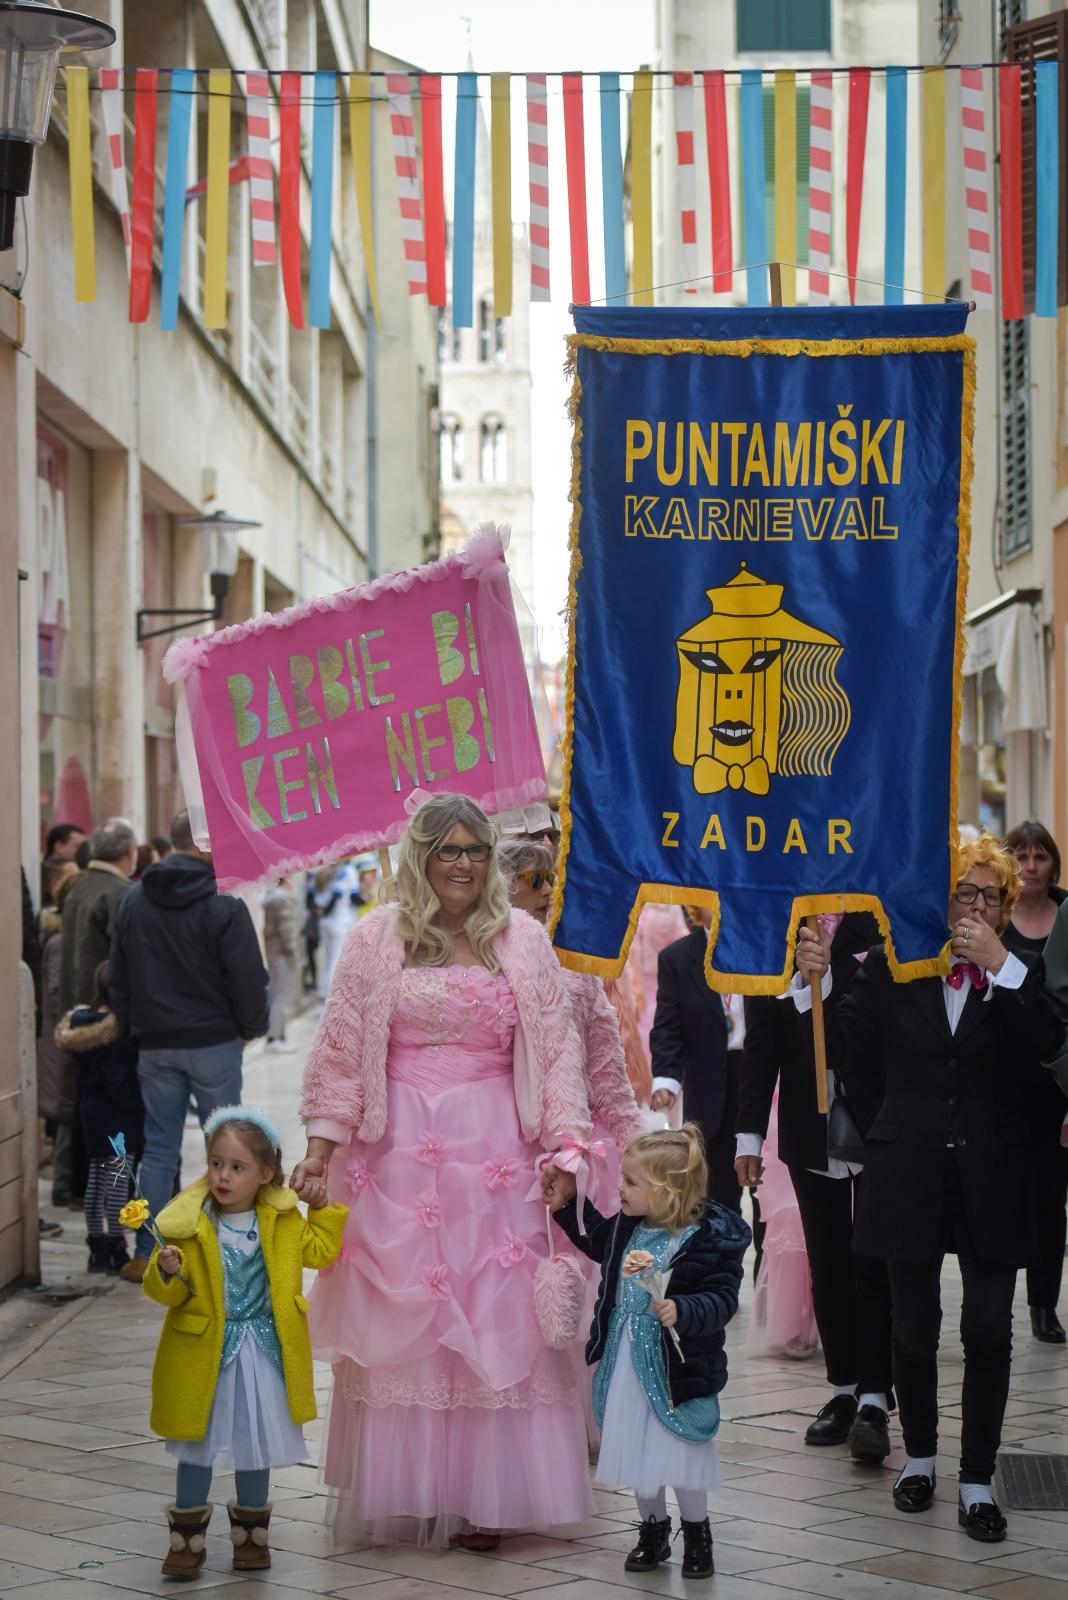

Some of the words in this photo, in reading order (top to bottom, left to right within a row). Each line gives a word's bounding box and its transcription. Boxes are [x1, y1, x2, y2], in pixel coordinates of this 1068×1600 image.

[625, 404, 906, 487] PUNTAMIŠKI
[625, 495, 899, 541] KARNEVAL
[228, 629, 394, 747] BARBIE
[432, 603, 479, 685] BI
[242, 737, 339, 830] KEN
[386, 687, 496, 792] NEBI
[662, 811, 853, 854] ZADAR
